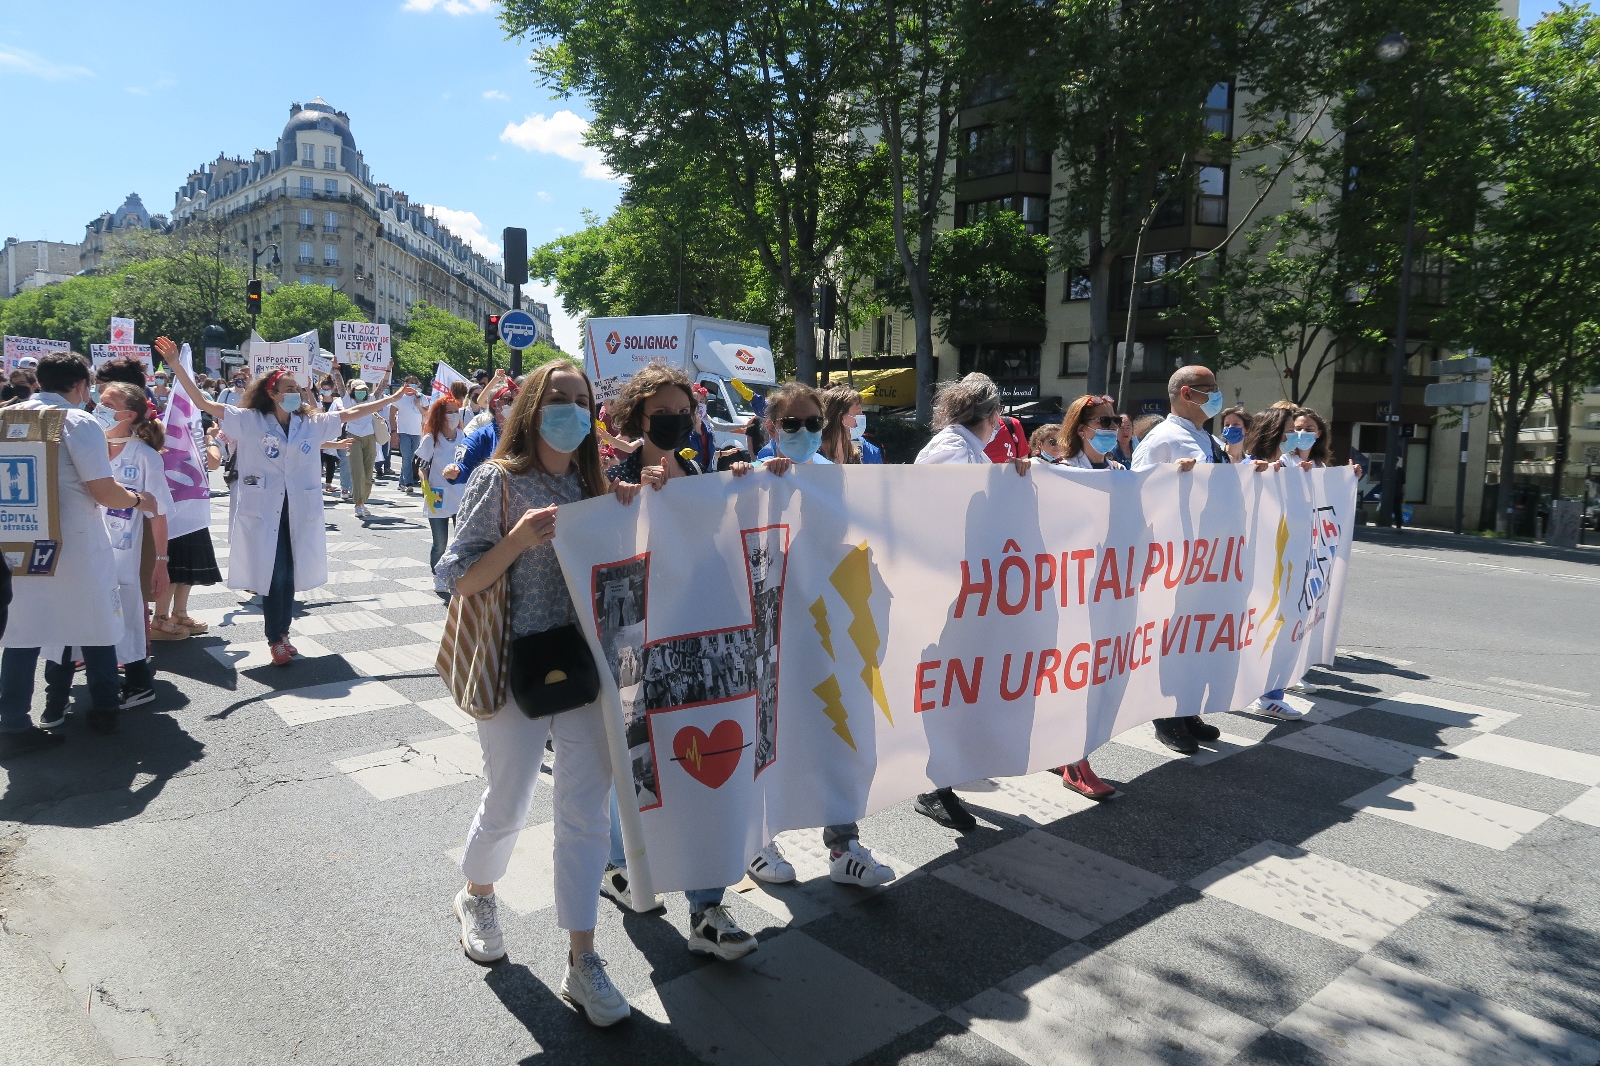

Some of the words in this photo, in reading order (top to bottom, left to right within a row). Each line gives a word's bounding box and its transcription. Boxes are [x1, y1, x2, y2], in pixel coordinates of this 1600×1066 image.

[341, 323, 355, 333] EN
[358, 325, 381, 335] 2021
[347, 334, 378, 342] ETUDIANT
[624, 335, 678, 350] SOLIGNAC
[345, 342, 361, 350] EST
[0, 510, 38, 523] ÔPITAL
[954, 539, 1136, 618] HÔPITAL
[1139, 535, 1245, 592] PUBLIC
[914, 657, 984, 713] EN
[999, 621, 1155, 701] URGENCE
[1161, 608, 1257, 657] VITALE
